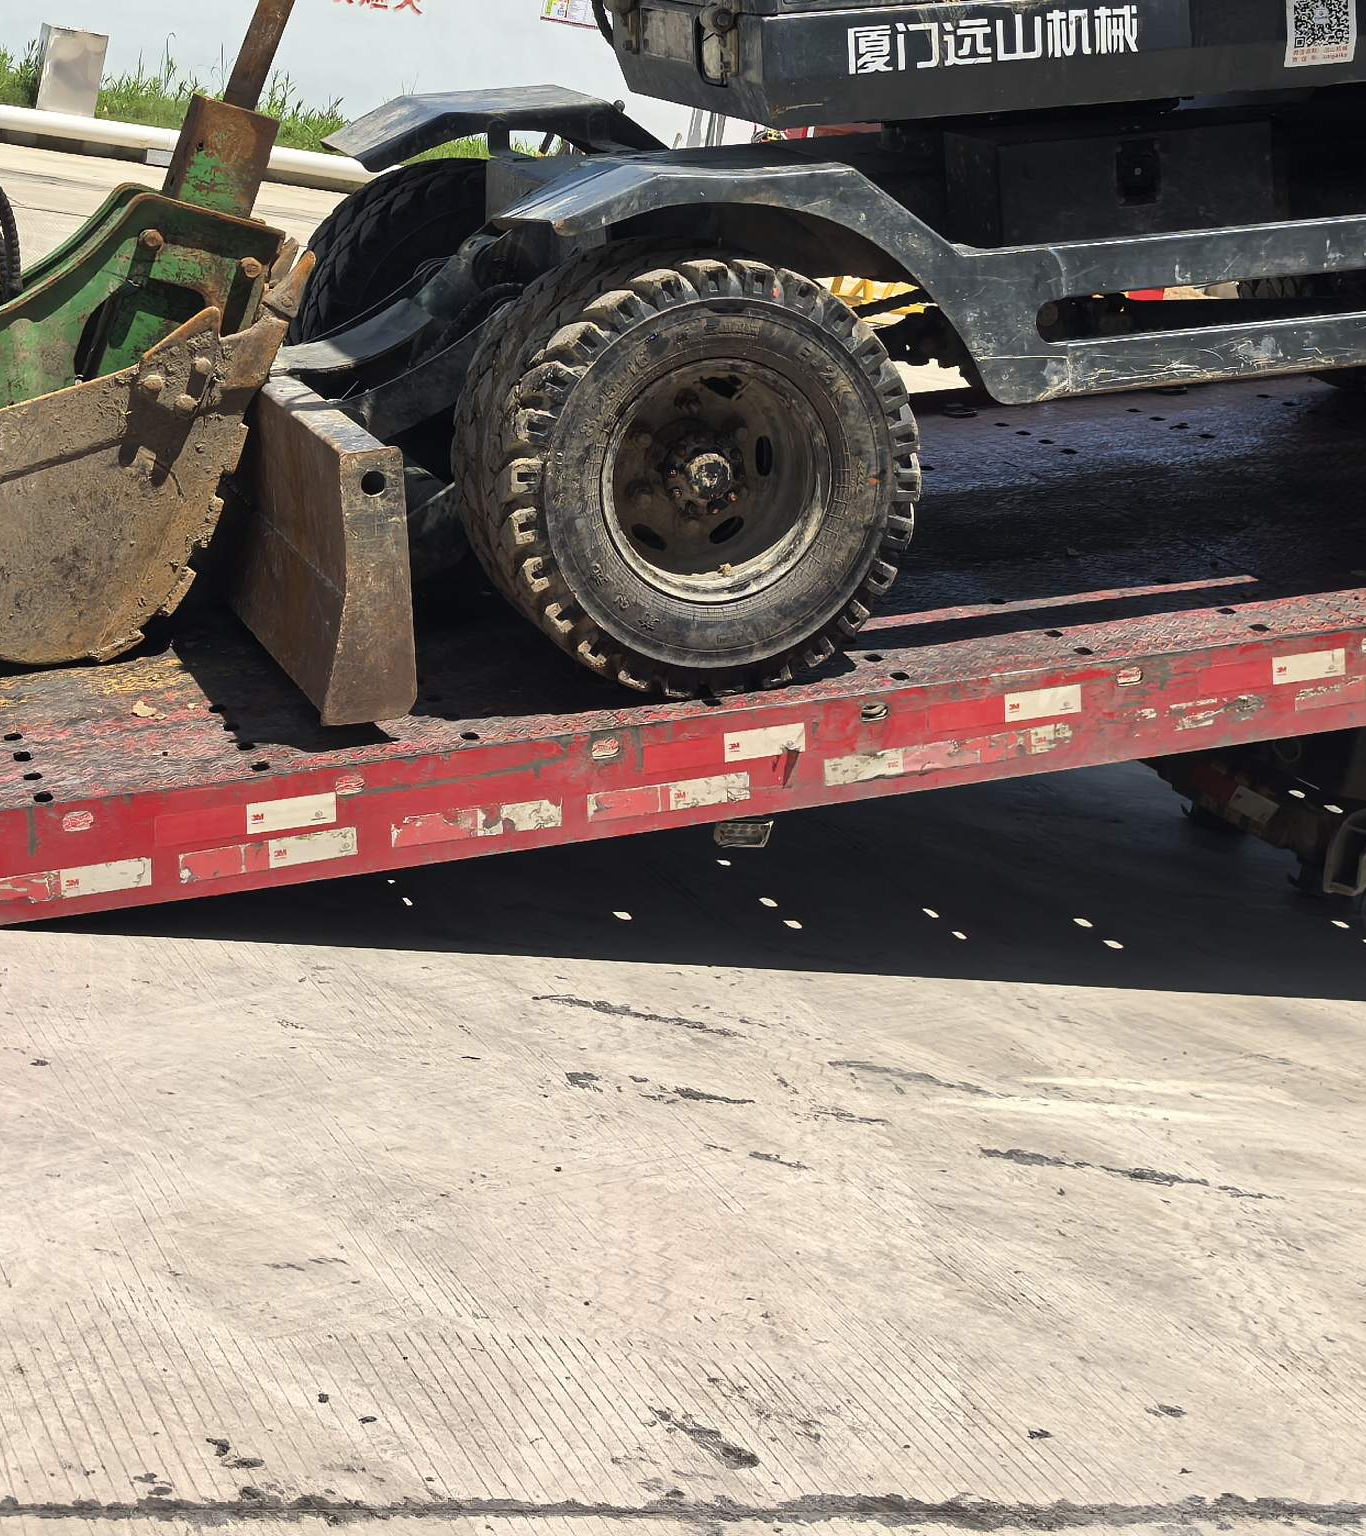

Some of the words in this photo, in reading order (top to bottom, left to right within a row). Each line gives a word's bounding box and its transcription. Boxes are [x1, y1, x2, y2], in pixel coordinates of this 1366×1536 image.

[847, 5, 1139, 75] 厦门远山机械
[728, 743, 740, 751] 3M
[251, 813, 265, 821] 3M
[273, 849, 287, 857] 3M
[66, 879, 79, 887] 3M
